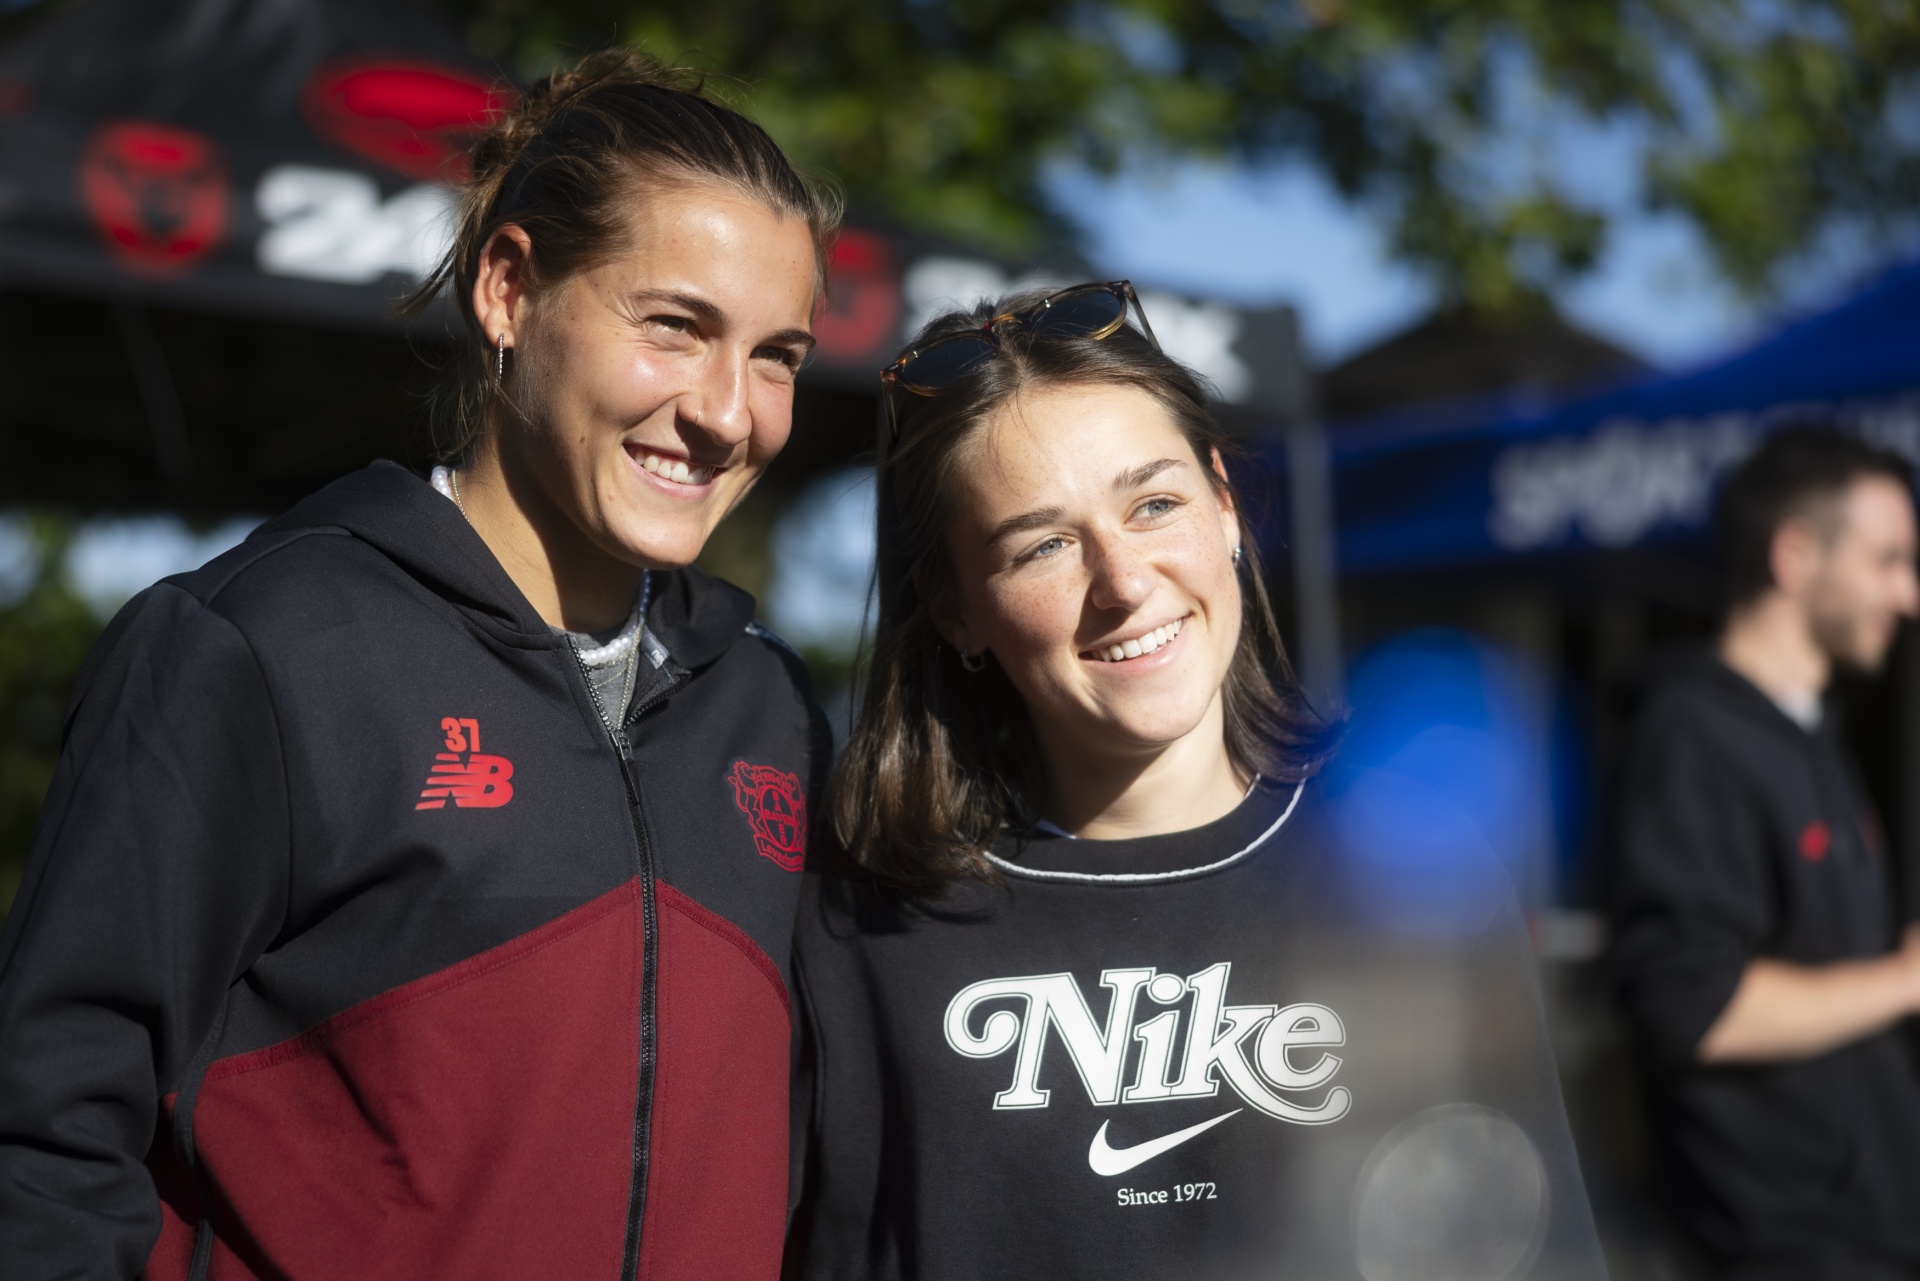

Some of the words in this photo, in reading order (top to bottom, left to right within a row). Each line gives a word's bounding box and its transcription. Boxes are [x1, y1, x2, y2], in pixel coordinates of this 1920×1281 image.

[441, 716, 480, 753] 37
[943, 961, 1352, 1125] Nike
[1117, 1187, 1169, 1206] Since
[1173, 1182, 1218, 1202] 1972
